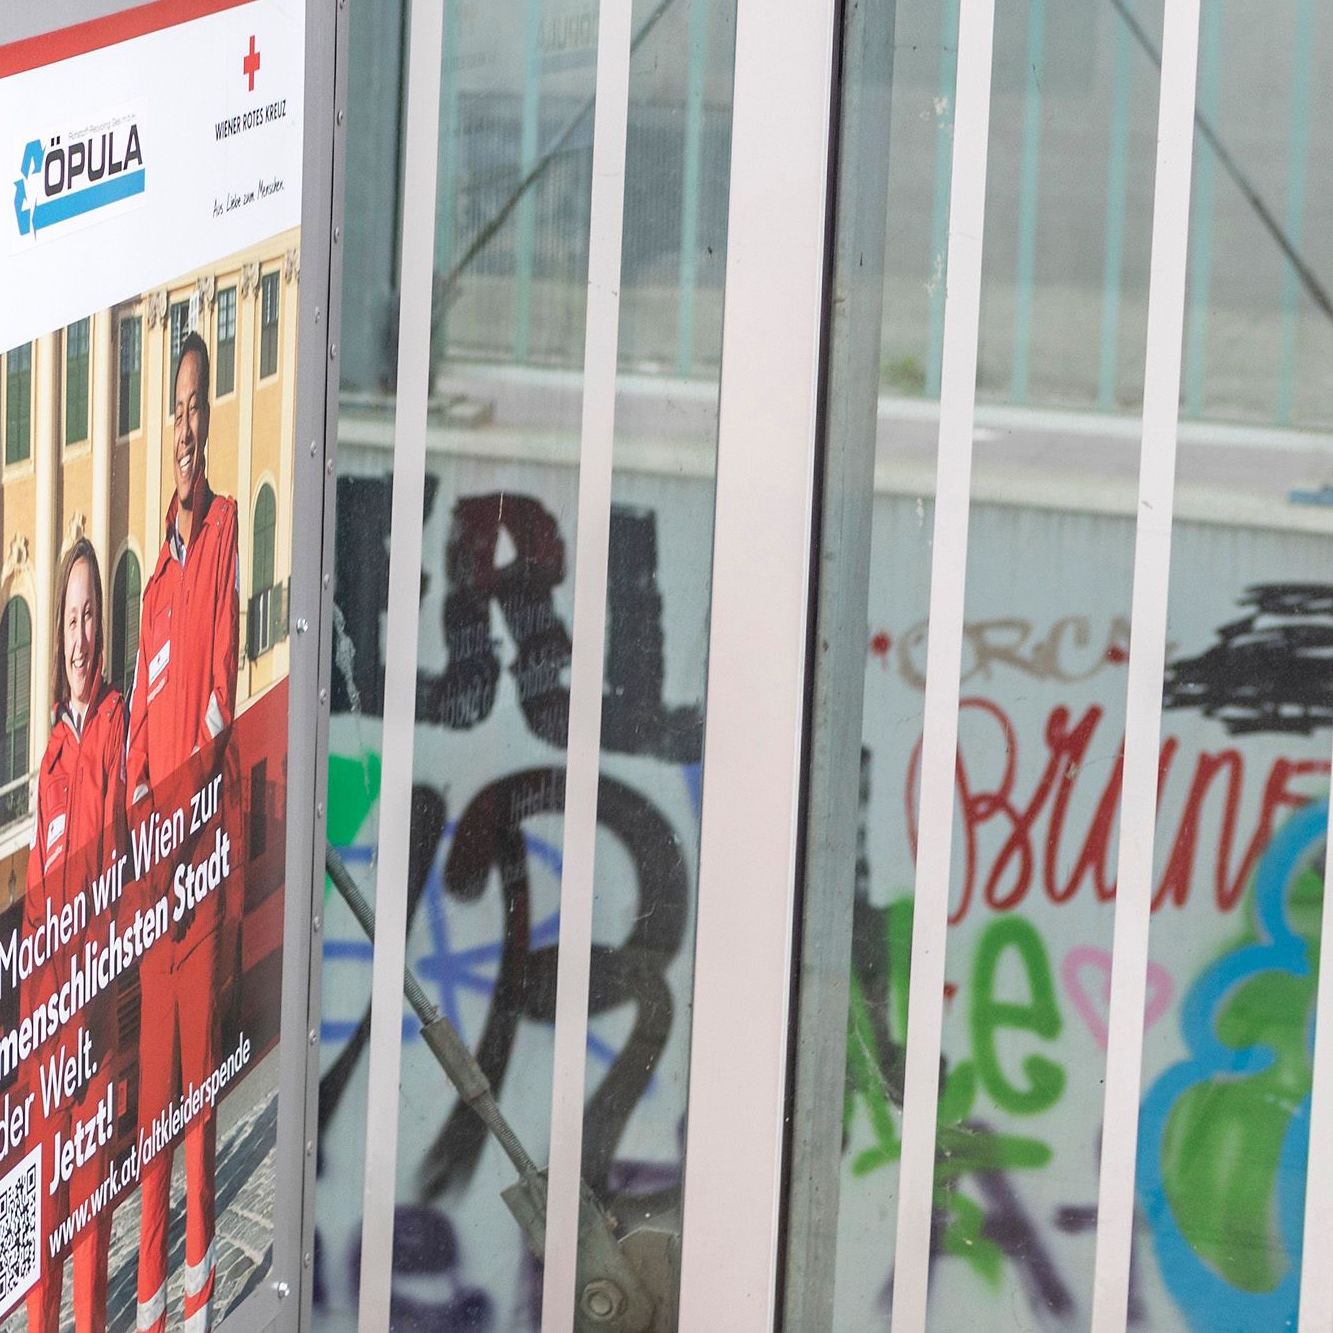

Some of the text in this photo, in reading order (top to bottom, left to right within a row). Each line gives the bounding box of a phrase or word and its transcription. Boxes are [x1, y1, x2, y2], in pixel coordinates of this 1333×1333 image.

[44, 123, 144, 198] ÖPULA
[215, 99, 287, 141] WIENER ROTES KREUZ
[92, 850, 127, 917] wir
[131, 806, 184, 882] Wien
[190, 773, 223, 835] zur
[172, 827, 231, 923] Stadt
[39, 1027, 98, 1119] Welt.
[48, 1082, 114, 1196] Jetzt!
[48, 1031, 251, 1259] www.wrk.at/altkleiderspende
